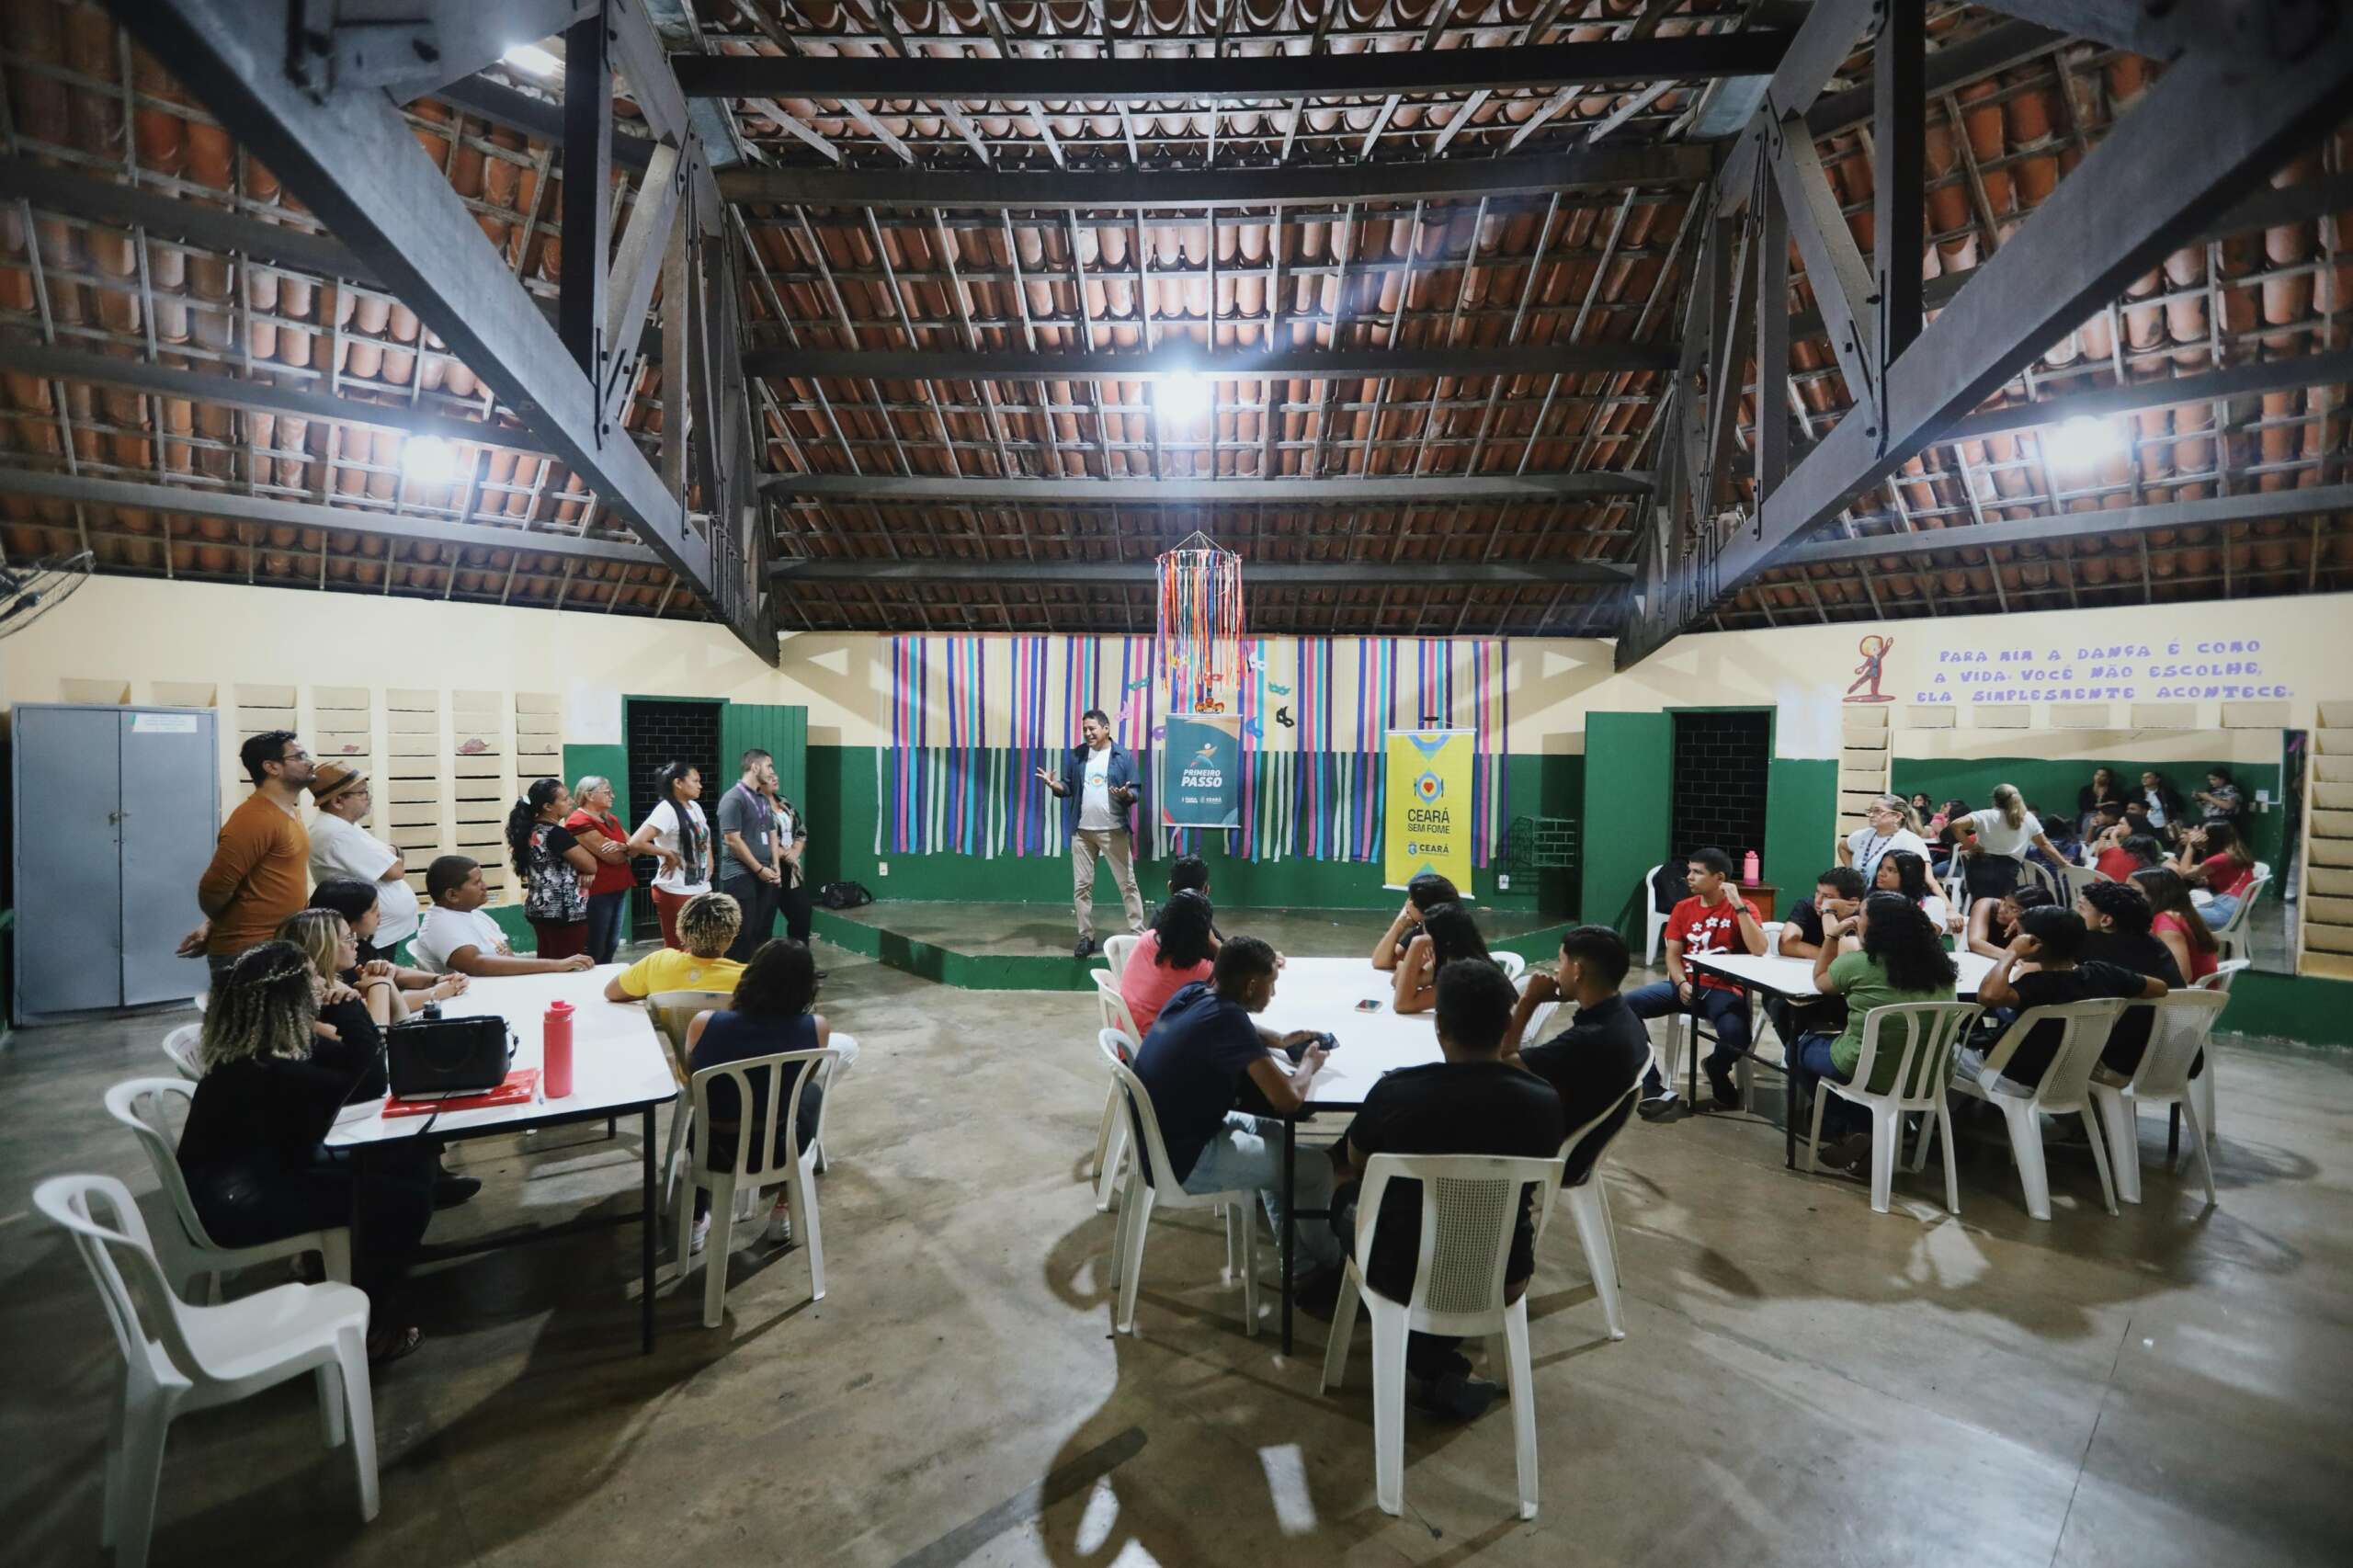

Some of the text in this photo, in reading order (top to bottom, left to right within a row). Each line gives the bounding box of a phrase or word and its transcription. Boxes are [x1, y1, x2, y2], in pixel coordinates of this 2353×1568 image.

[1939, 651, 1988, 663] PARA
[2048, 650, 2061, 661] A
[2077, 645, 2151, 660] DANÇA
[2167, 637, 2180, 655] É
[2197, 641, 2260, 653] COMO
[1934, 673, 1947, 684] A
[2020, 665, 2074, 681] VOCÊ
[2090, 665, 2133, 678] NÃO
[1916, 691, 1952, 702] ELA
[1972, 687, 2135, 701] SIMPLESMENTE
[1181, 777, 1222, 787] PASSO
[1407, 807, 1450, 824] CEARÁ
[1407, 824, 1450, 834] SEM FOME
[1419, 844, 1449, 853] CEARÁ
